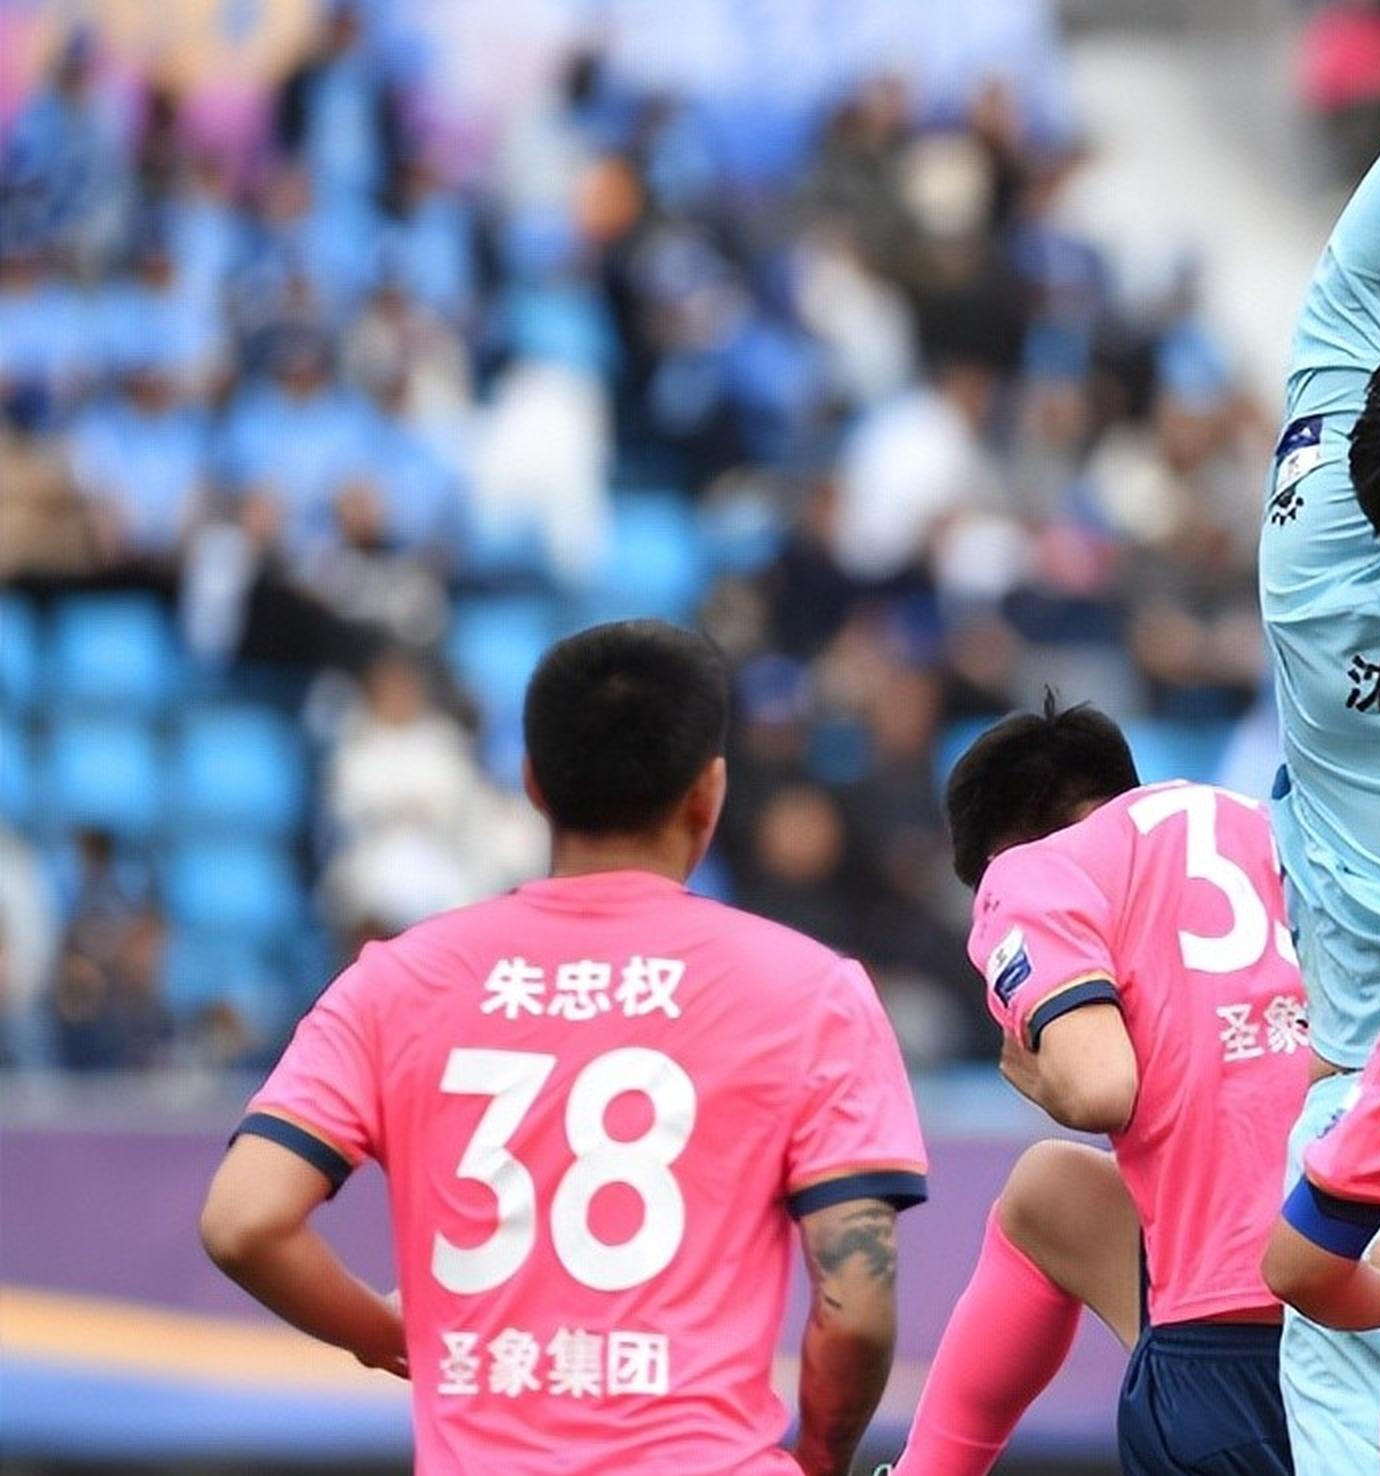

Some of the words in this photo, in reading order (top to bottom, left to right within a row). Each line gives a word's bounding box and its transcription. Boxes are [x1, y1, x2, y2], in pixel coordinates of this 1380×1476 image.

[1127, 784, 1299, 974] 3
[480, 955, 687, 1021] 朱忠权
[430, 1045, 698, 1295] 38
[436, 1326, 671, 1399] 圣象集团
